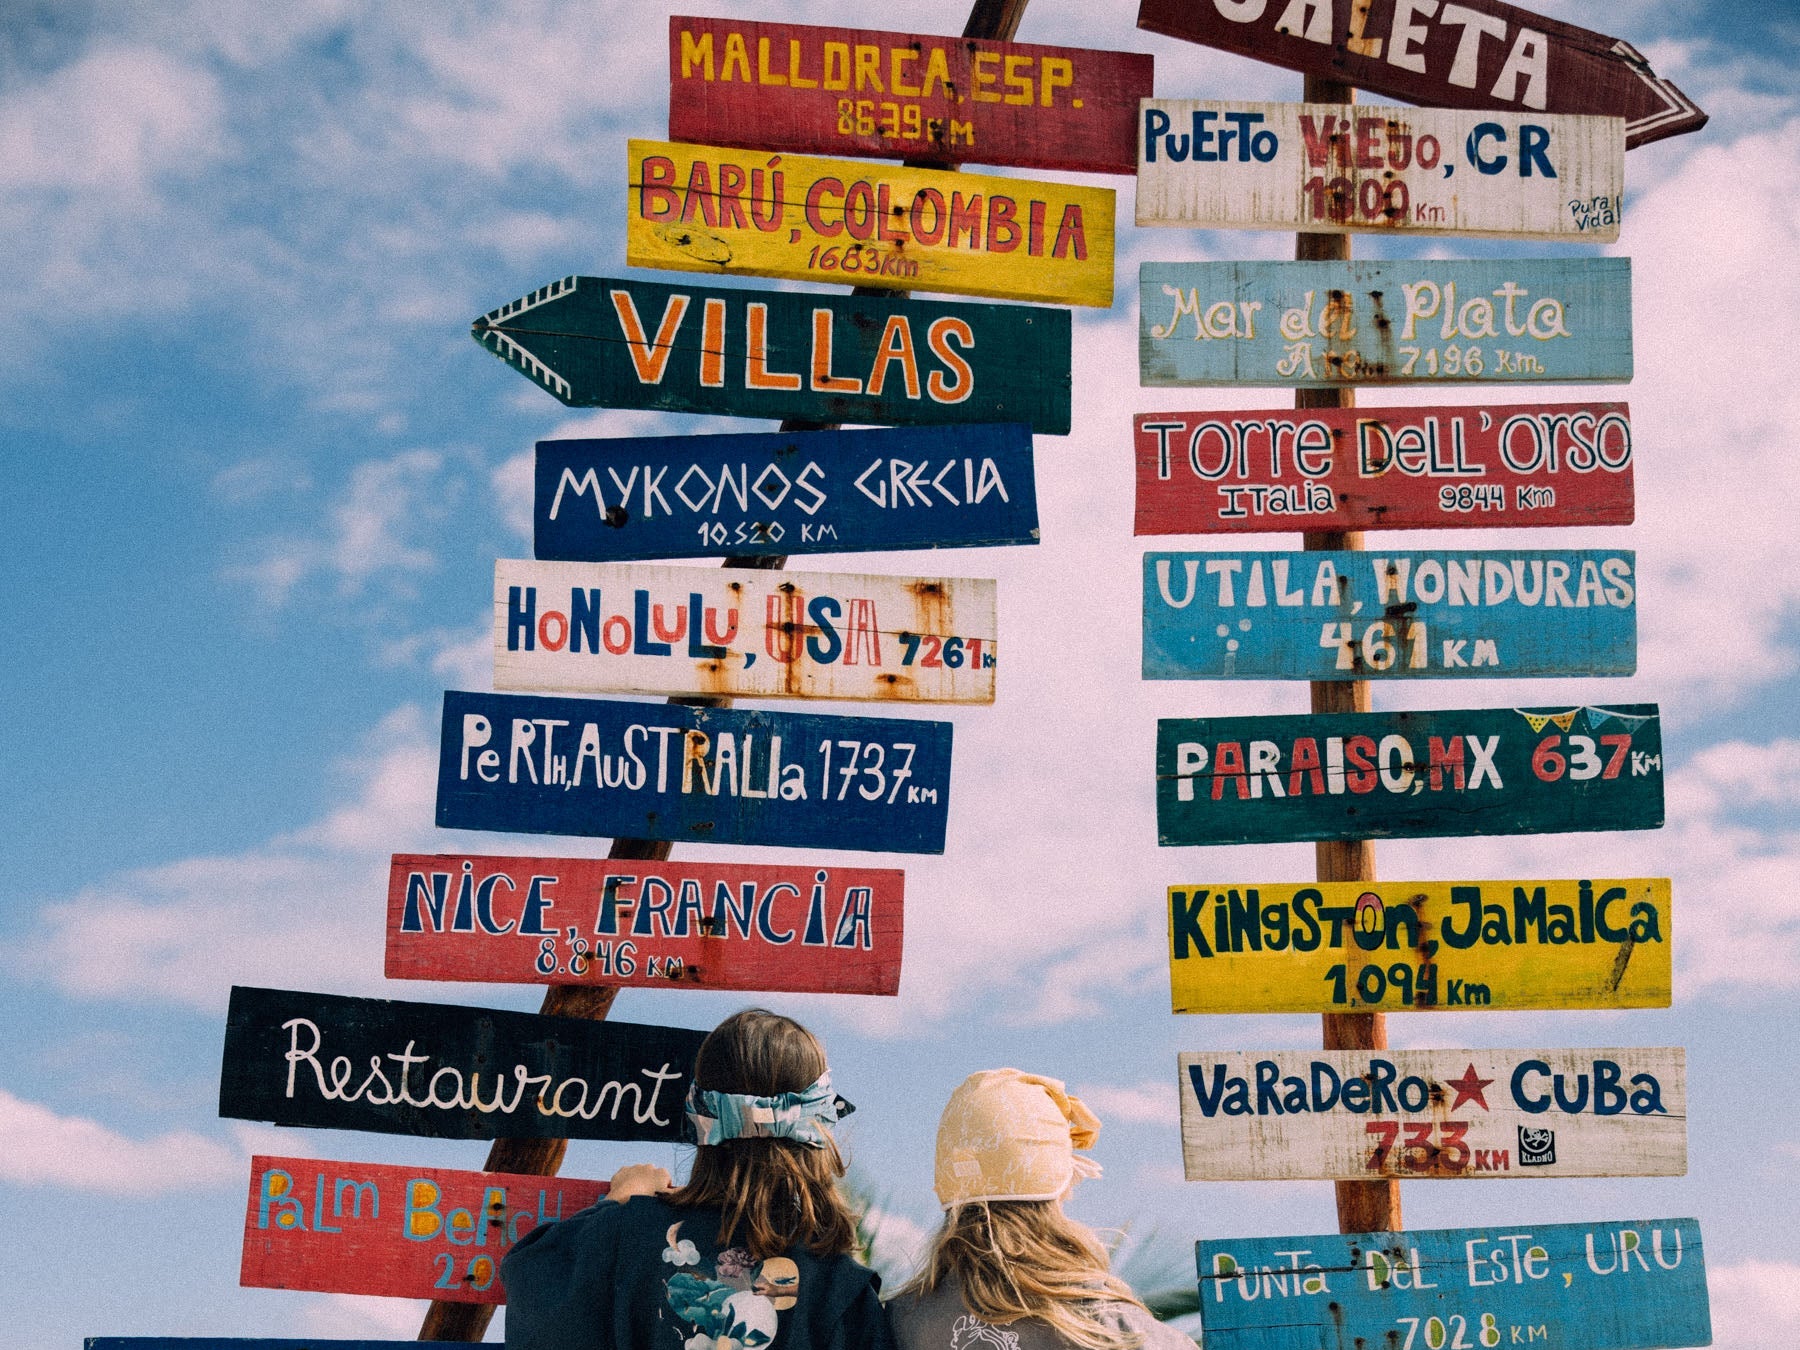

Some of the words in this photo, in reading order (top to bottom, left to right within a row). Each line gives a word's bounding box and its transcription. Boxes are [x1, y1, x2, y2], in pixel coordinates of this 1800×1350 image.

[680, 31, 965, 105] MALLORCA,
[970, 51, 1083, 107] ESP.
[1466, 121, 1557, 179] CR
[640, 156, 800, 244] BARÚ,
[805, 177, 1088, 260] COLOMBIA
[1568, 196, 1609, 217] Pura
[1575, 195, 1621, 231] Vida!
[1151, 284, 1262, 340] Mar
[1280, 289, 1358, 341] del
[1400, 280, 1571, 340] Plata
[610, 290, 975, 403] VILLAS
[1399, 345, 1485, 378] 7196
[549, 459, 828, 521] MYKONOS
[853, 456, 1009, 510] GRECIA
[1439, 485, 1507, 512] 9844
[801, 523, 838, 543] KM
[1155, 559, 1362, 614] UTILA,
[1371, 558, 1635, 609] HONDURAS
[765, 594, 883, 667] USA
[1319, 621, 1428, 671] 461
[1443, 639, 1500, 668] KM
[535, 938, 637, 977] 8.846
[282, 1018, 682, 1127] Restaurant
[1584, 1228, 1683, 1275] URU
[1510, 1324, 1548, 1344] KM
